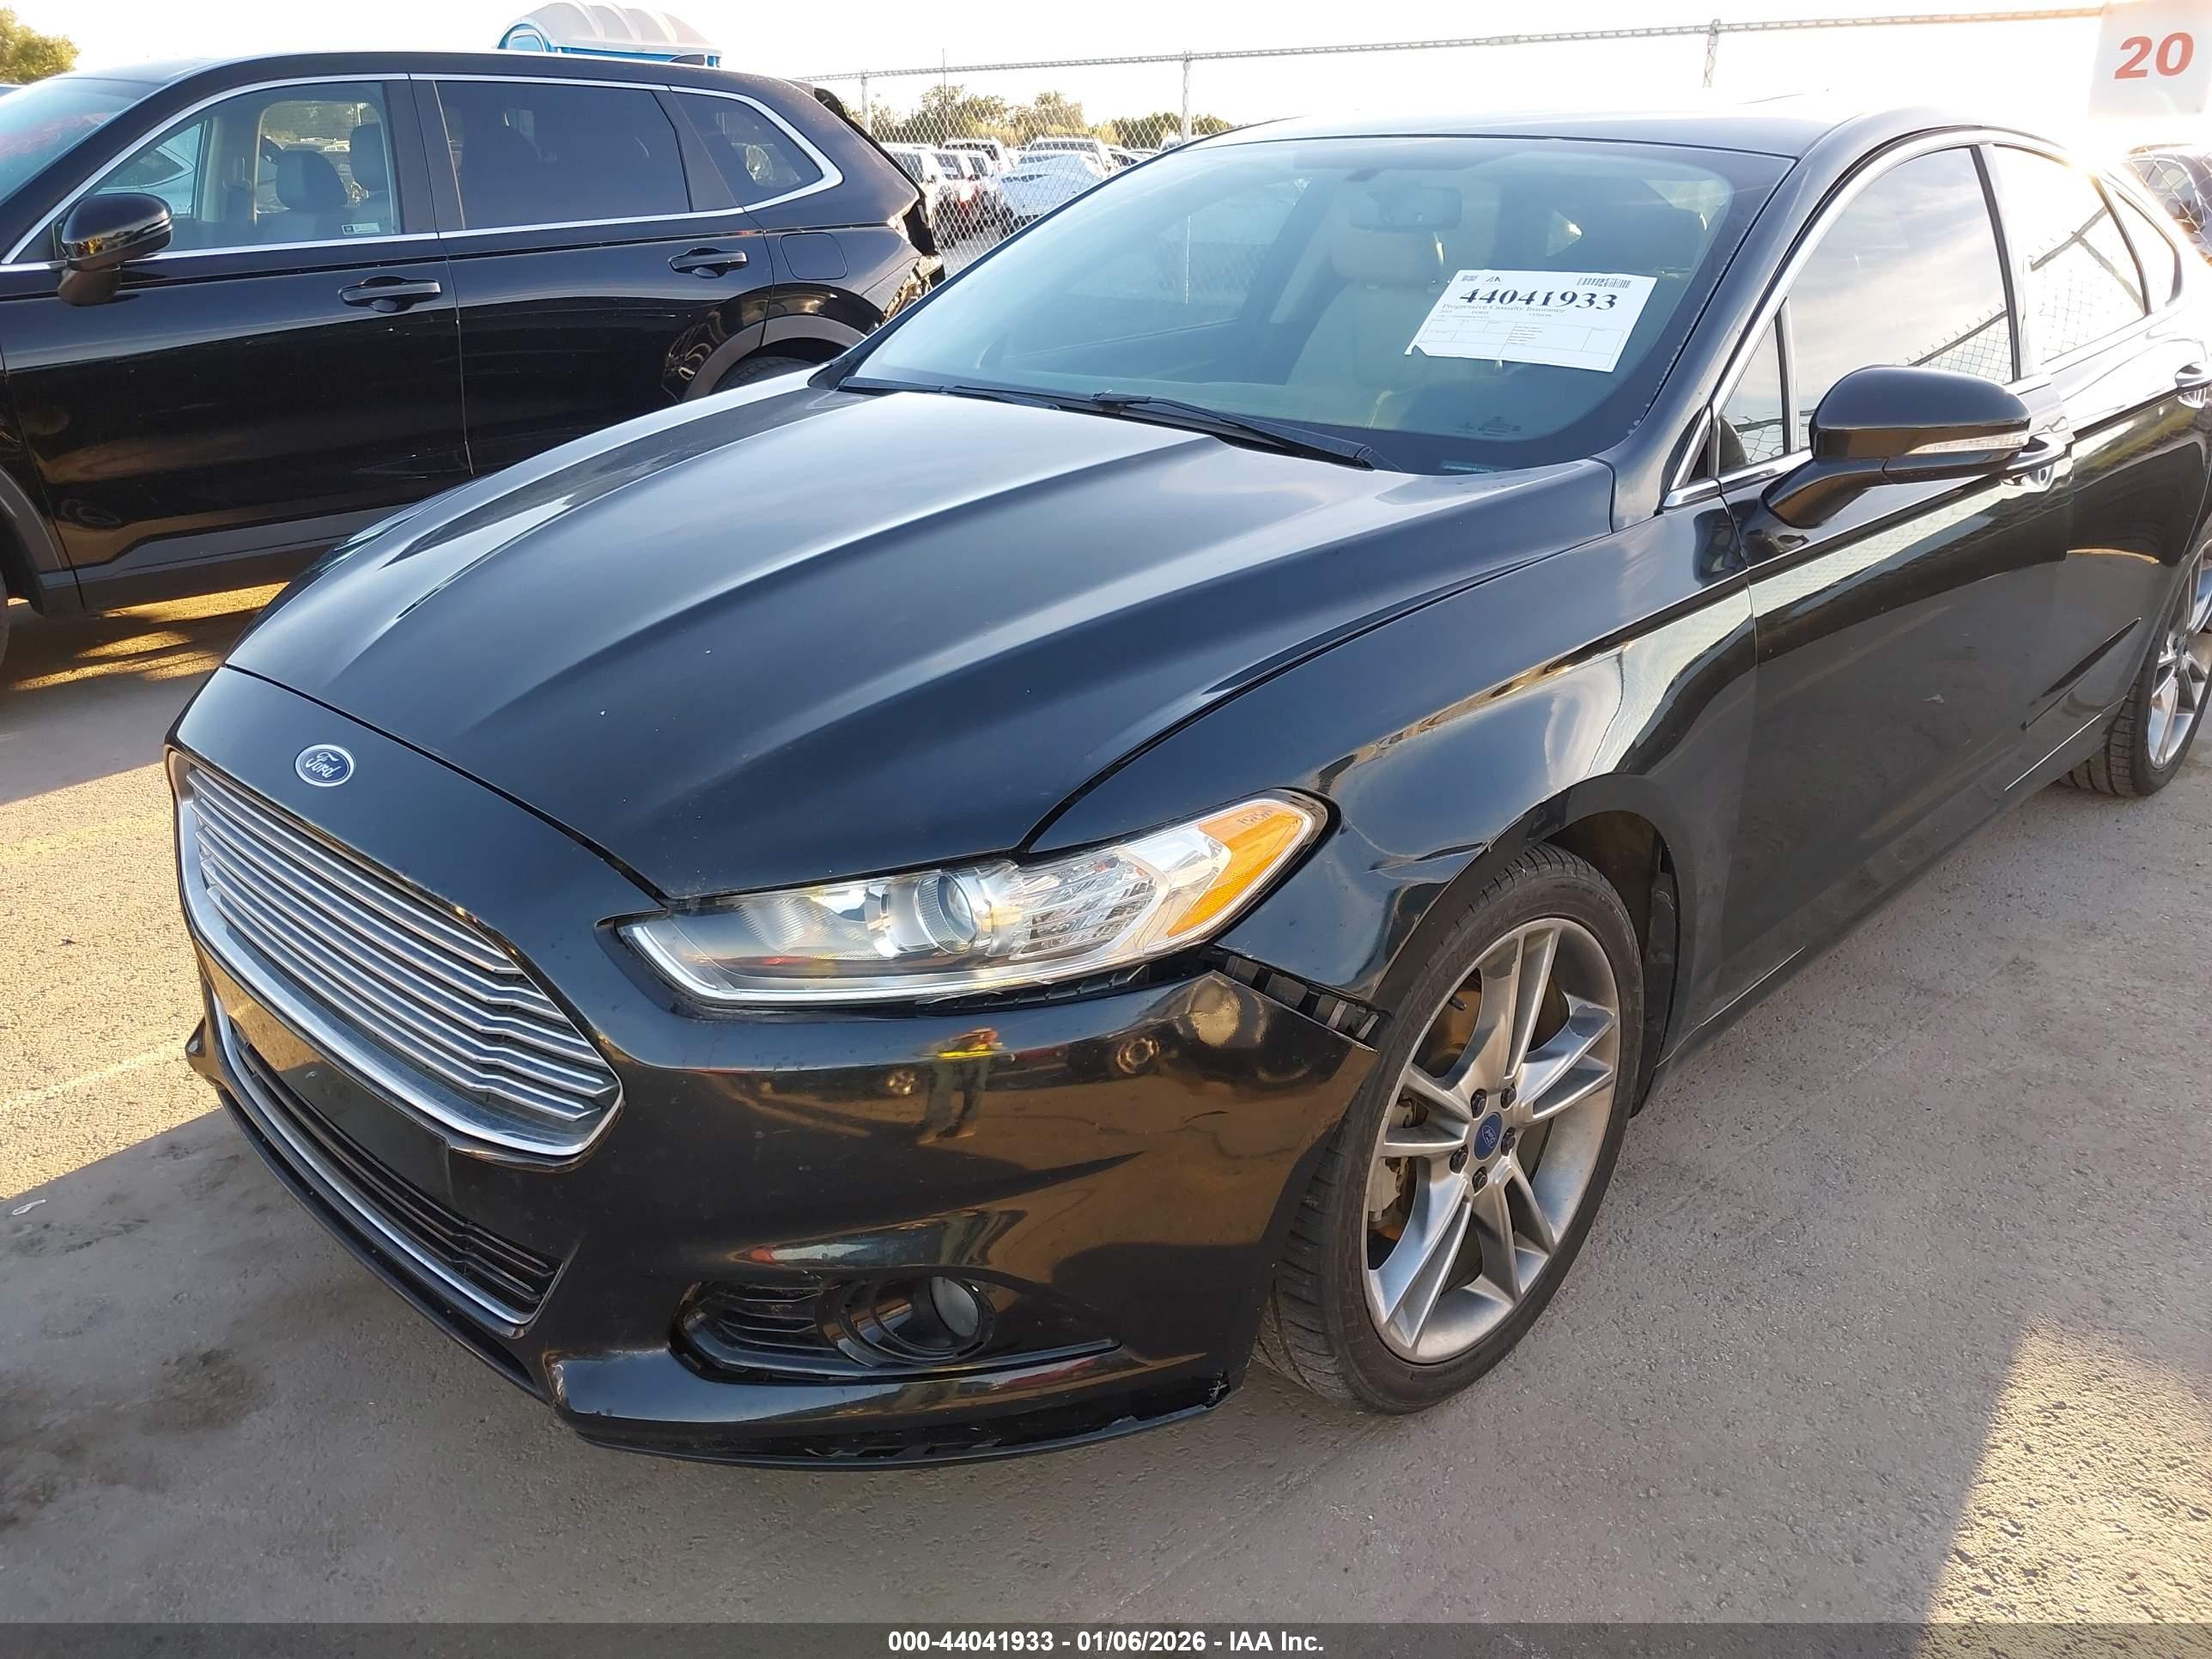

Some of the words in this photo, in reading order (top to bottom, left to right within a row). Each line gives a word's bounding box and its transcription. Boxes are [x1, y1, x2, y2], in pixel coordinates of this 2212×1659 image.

[2114, 32, 2194, 79] 20
[1460, 289, 1618, 310] 44041933
[305, 751, 342, 779] Ford
